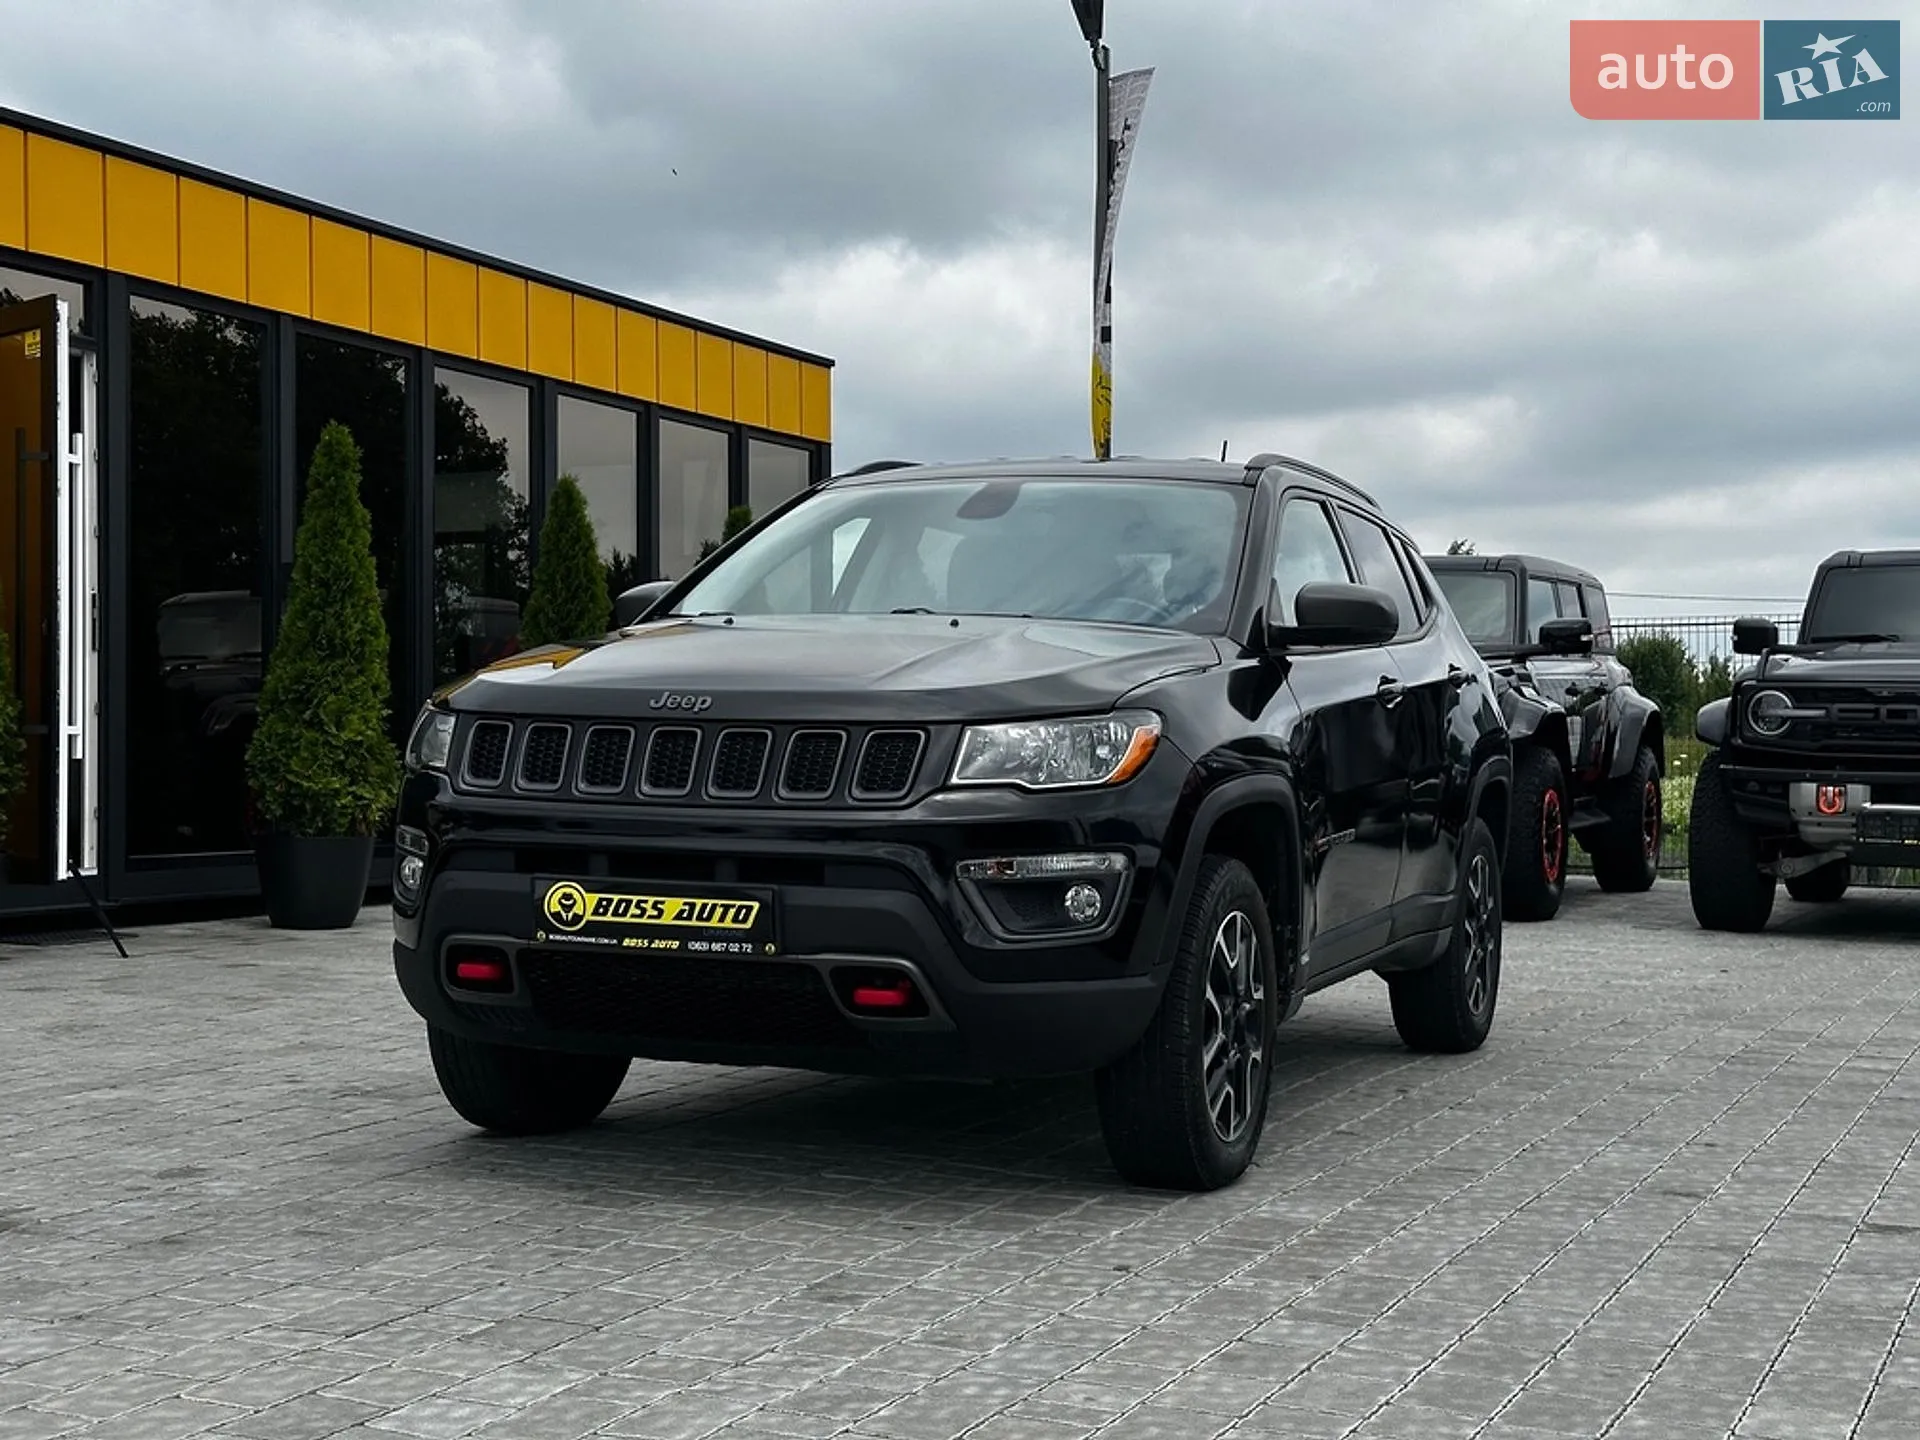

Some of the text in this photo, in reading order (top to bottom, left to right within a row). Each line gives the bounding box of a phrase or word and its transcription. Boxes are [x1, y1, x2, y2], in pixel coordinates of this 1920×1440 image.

[649, 691, 712, 712] Jeep
[591, 897, 753, 924] BOSS AUTO
[621, 937, 649, 948] BOSS
[650, 938, 680, 949] AUTO
[741, 943, 753, 953] 72
